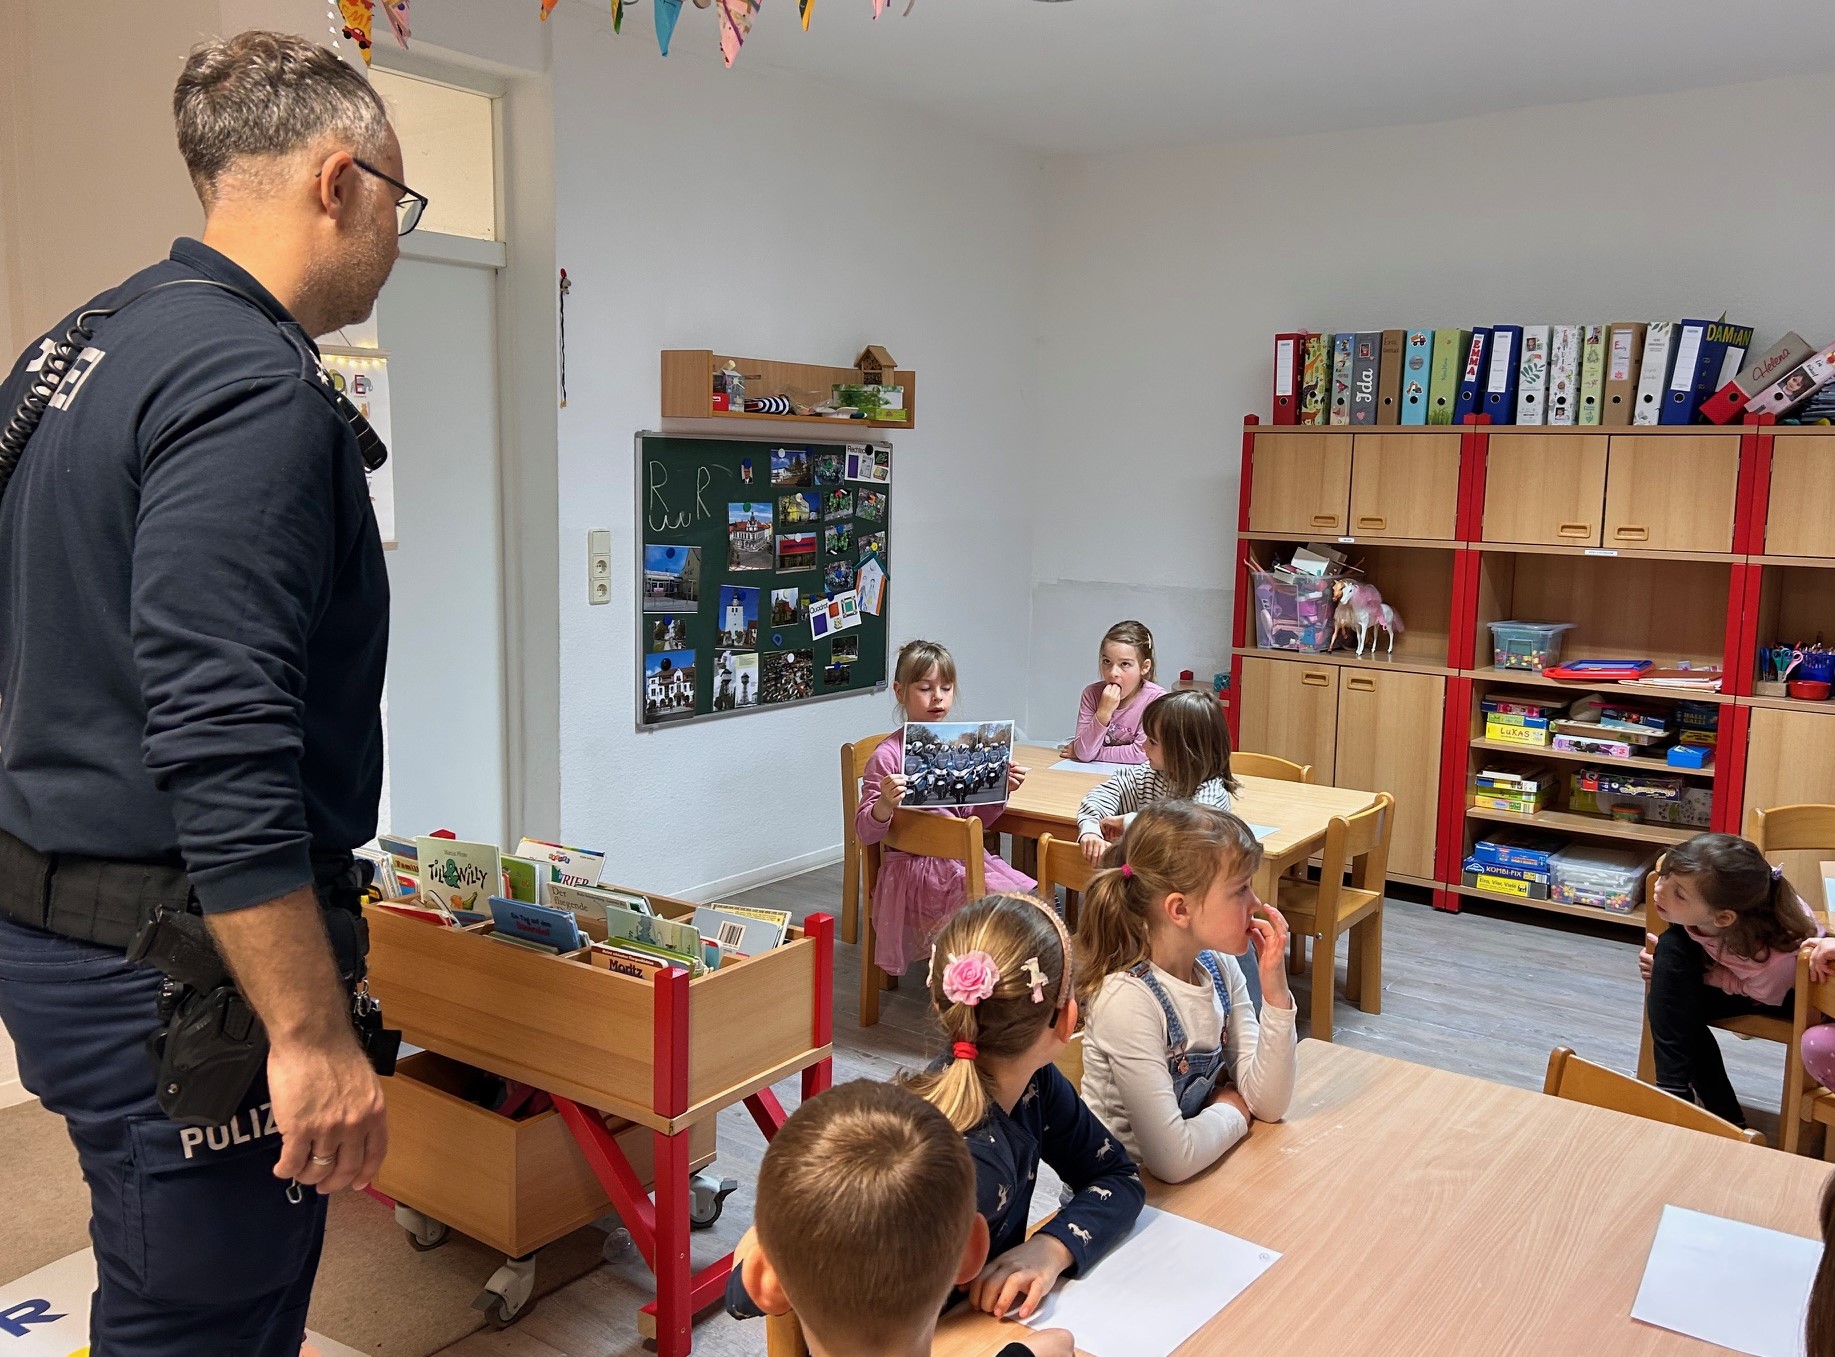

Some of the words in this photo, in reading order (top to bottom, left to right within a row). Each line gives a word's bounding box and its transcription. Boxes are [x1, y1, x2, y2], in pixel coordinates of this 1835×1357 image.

[1467, 339, 1481, 376] EMMA
[1752, 348, 1791, 381] Helena
[354, 374, 367, 395] E
[1355, 367, 1374, 403] Ida
[847, 445, 866, 454] Rechtec
[809, 602, 828, 614] Quadrat
[551, 886, 567, 898] Der
[554, 897, 589, 912] fliegende
[608, 958, 644, 979] Moritz
[179, 1102, 280, 1159] POLIZ
